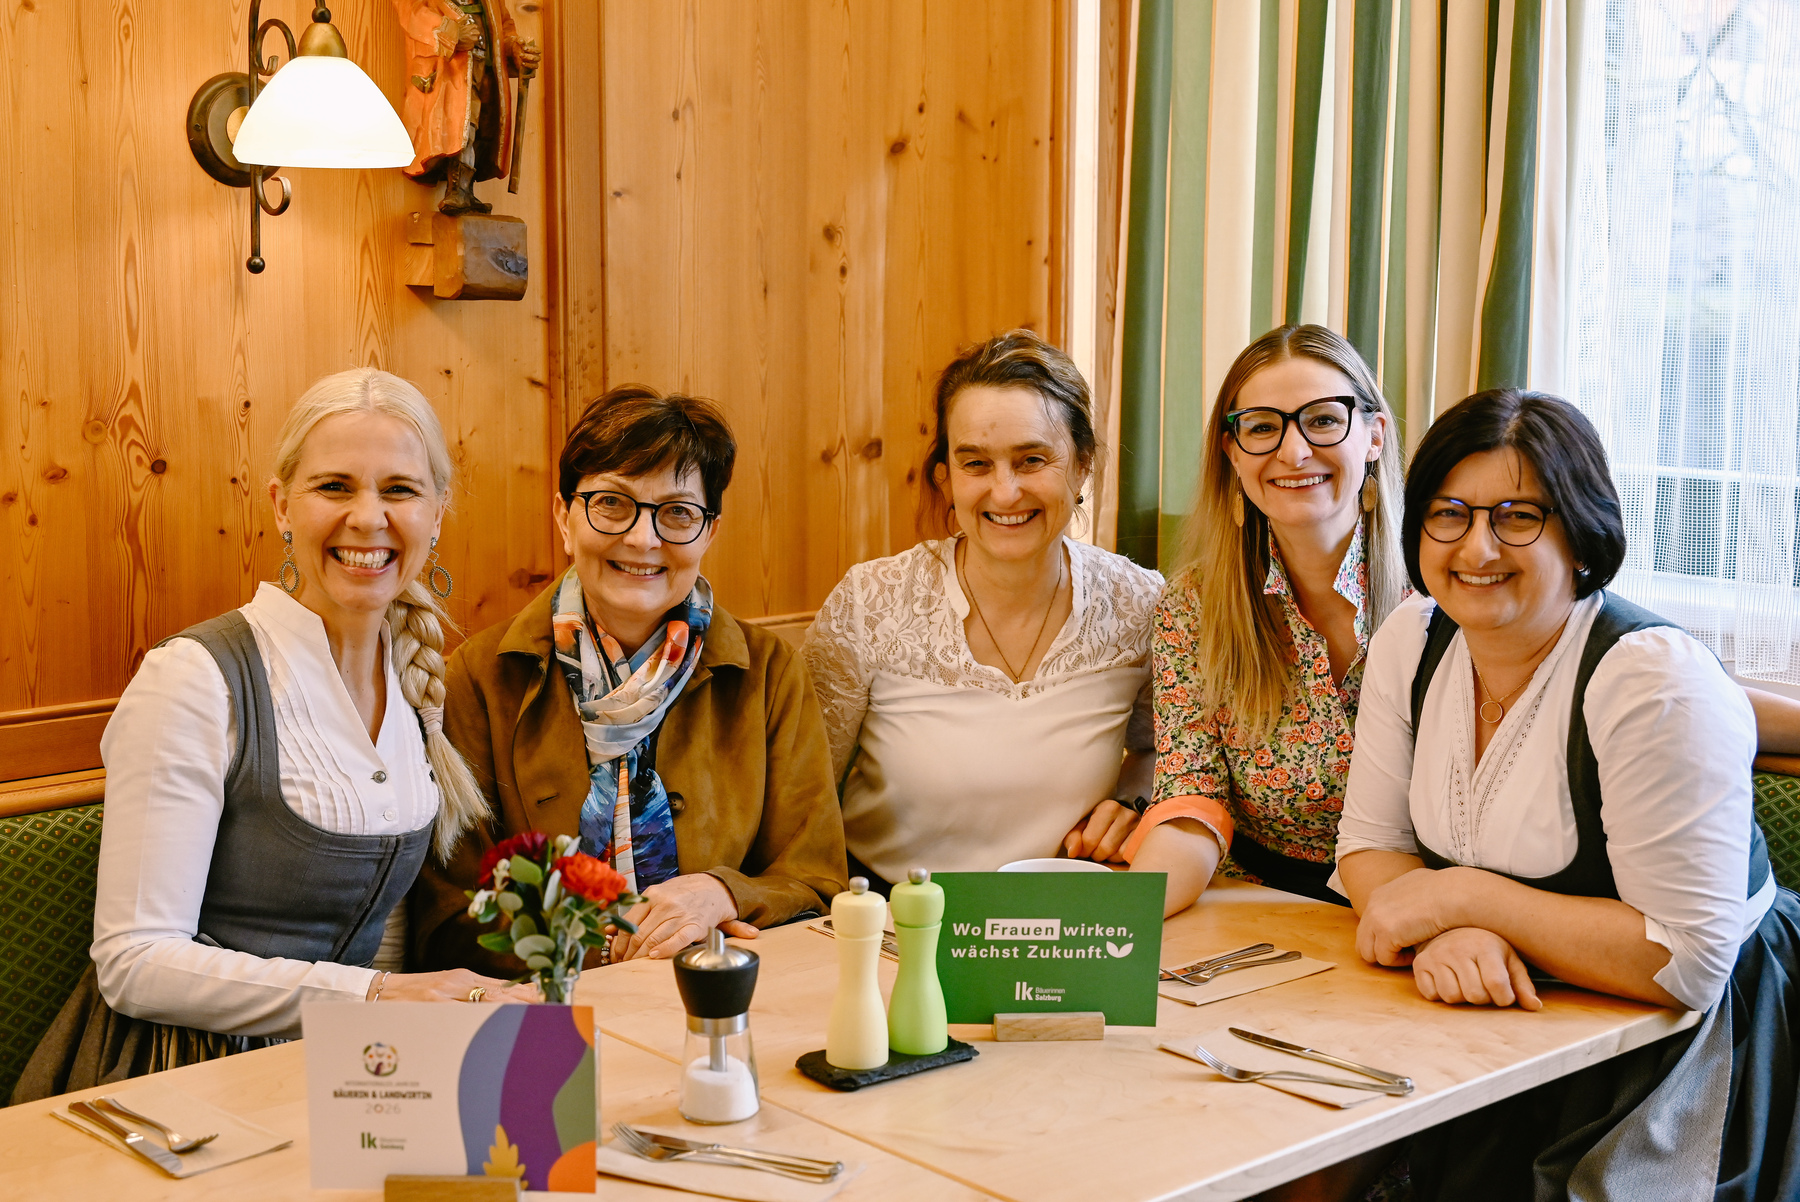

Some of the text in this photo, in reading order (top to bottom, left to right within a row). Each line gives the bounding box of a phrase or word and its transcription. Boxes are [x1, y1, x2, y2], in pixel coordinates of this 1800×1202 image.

[952, 922, 1134, 939] Wo Frauen wirken,
[951, 945, 1108, 959] wächst Zukunft.
[1035, 994, 1062, 1002] Salzburg
[333, 1088, 433, 1099] BÄUERIN & LANDWIRTIN
[365, 1103, 401, 1115] 2026
